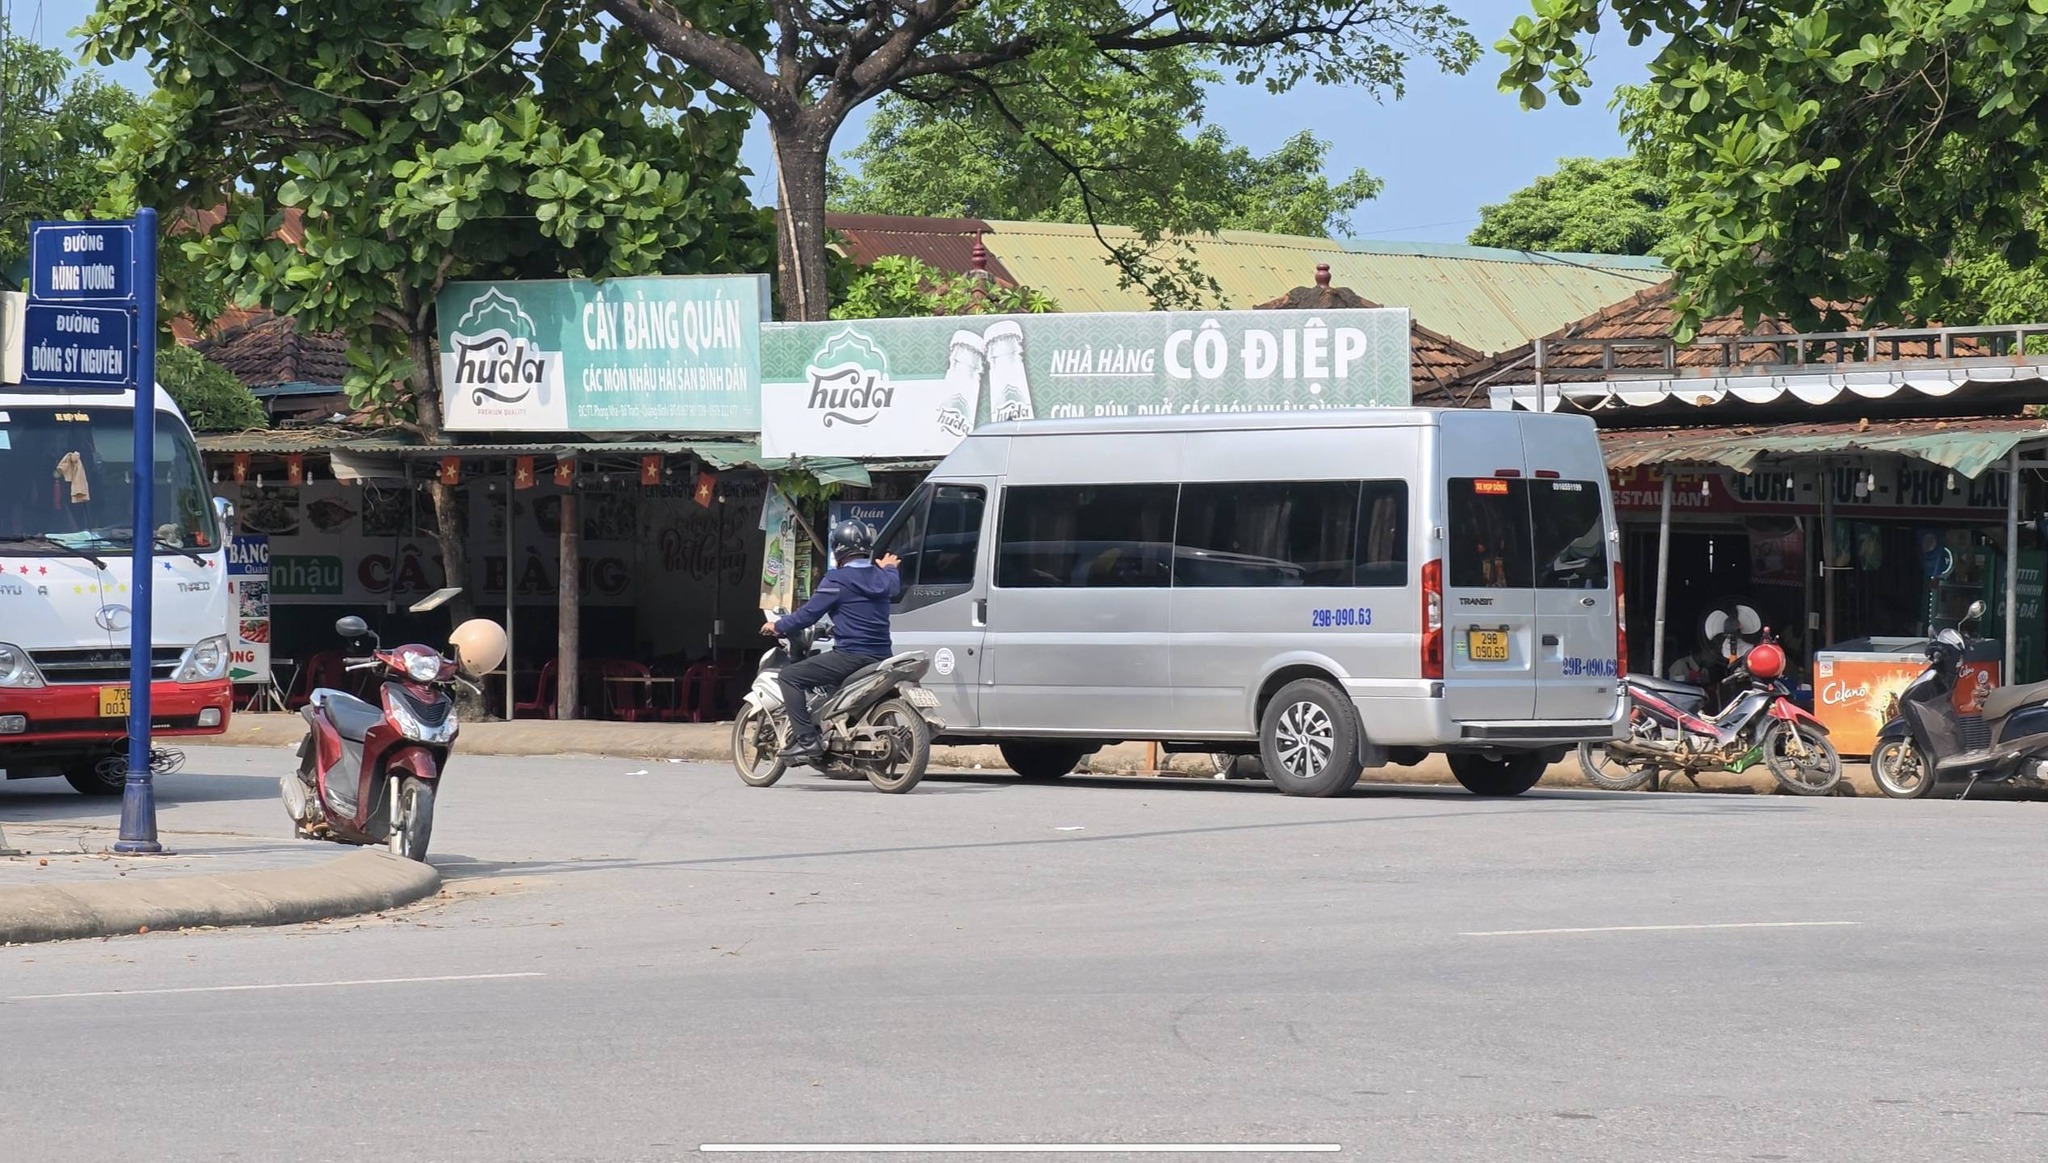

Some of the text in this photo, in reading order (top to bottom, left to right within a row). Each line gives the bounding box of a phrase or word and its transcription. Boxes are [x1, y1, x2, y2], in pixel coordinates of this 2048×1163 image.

[63, 230, 104, 252] ĐƯỜNG
[52, 260, 115, 290] HÙNG VƯƠNG
[56, 310, 100, 334] ĐƯỜNG
[582, 288, 741, 354] CÂY BÀNG QUÁN
[32, 337, 123, 374] ĐỒNG SỸ NGUYÊN
[455, 337, 545, 384] huda
[1050, 317, 1368, 395] NHÀ HÀNG CÔ ĐIỆP
[582, 360, 747, 398] CÁC MÓN NHẬU HẢI SẢN BÌNH DÂN
[807, 368, 895, 409] huda
[850, 505, 884, 520] Quán
[229, 540, 269, 564] BÀNG
[177, 582, 210, 592] THACO
[271, 559, 340, 593] nhậu
[1459, 597, 1493, 606] TRANSIT
[1312, 608, 1372, 627] 29B-090.63
[1481, 633, 1498, 645] 29B
[1475, 646, 1506, 659] 090.63
[1562, 657, 1618, 677] 29B-090.63
[1822, 680, 1867, 705] Celano
